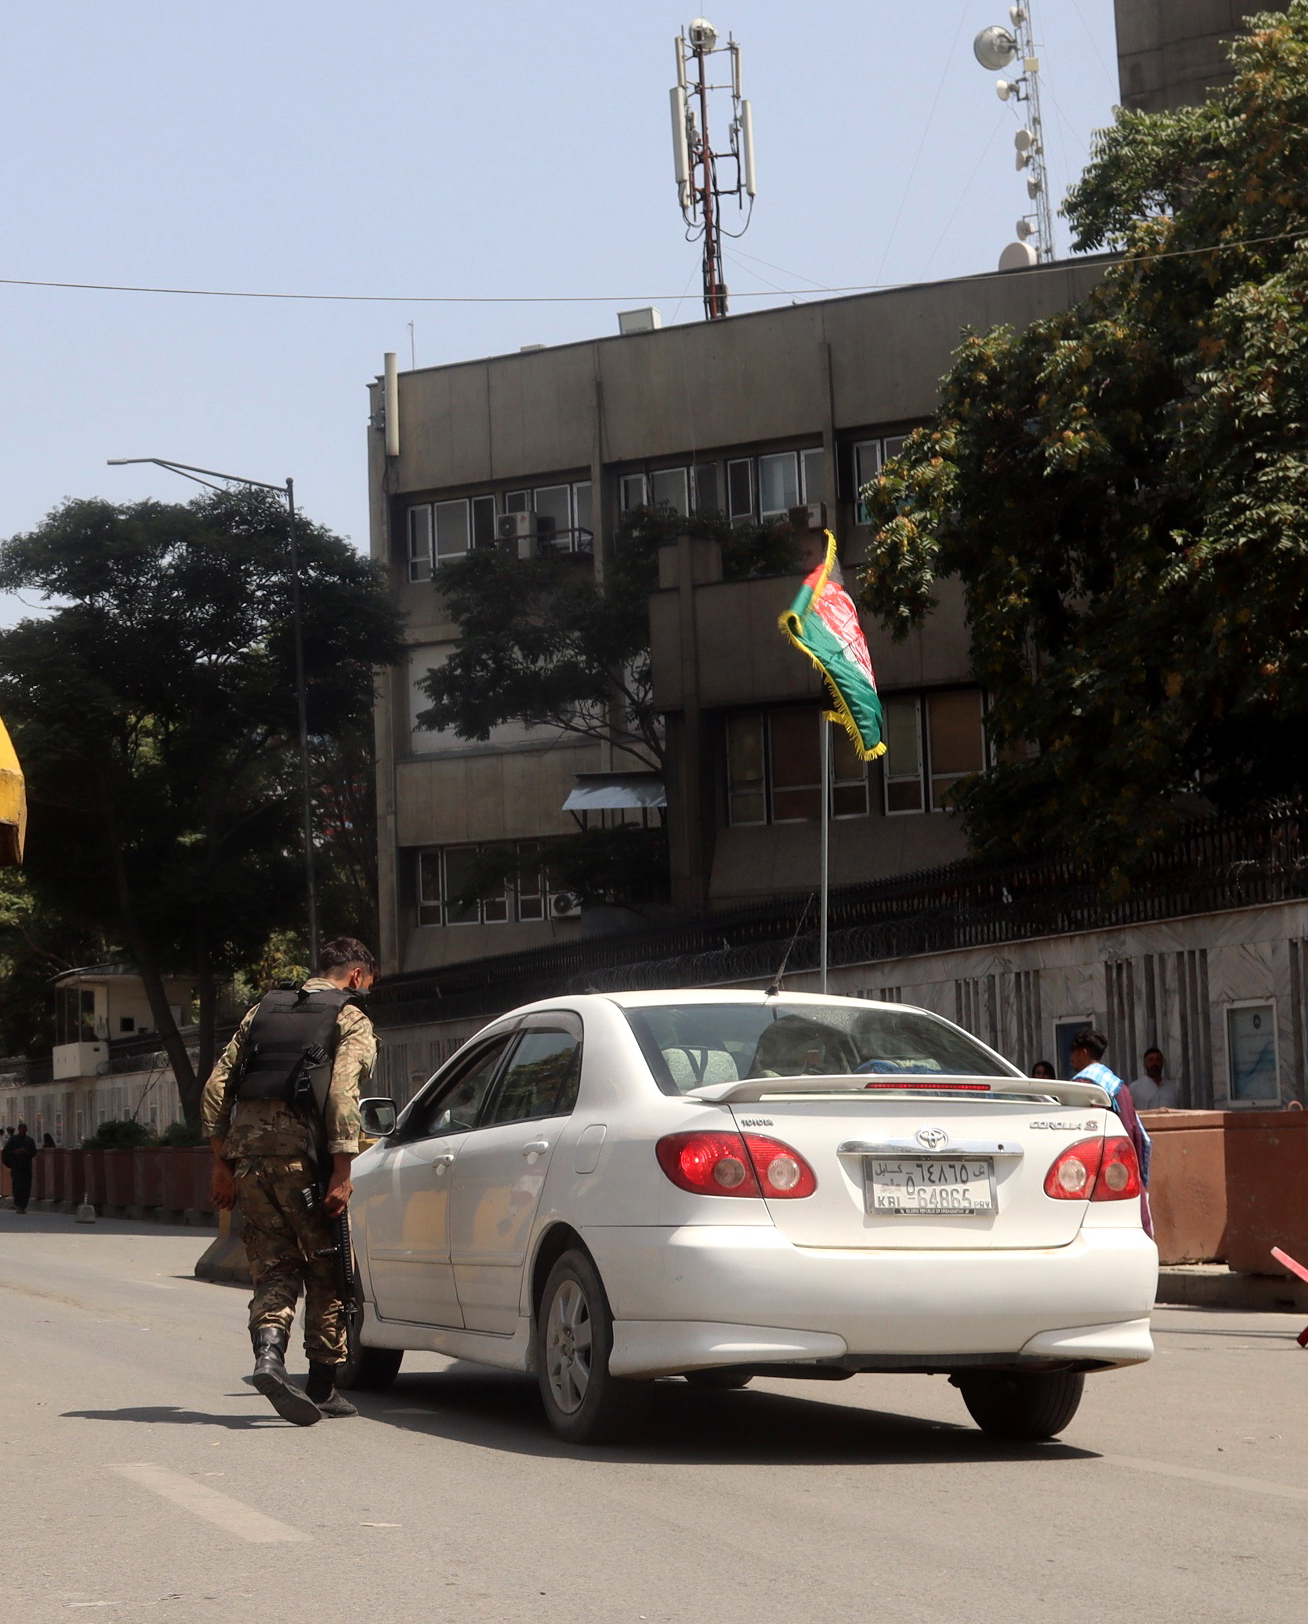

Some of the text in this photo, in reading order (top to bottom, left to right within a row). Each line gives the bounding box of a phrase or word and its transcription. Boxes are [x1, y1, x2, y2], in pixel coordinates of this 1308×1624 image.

[740, 1118, 774, 1127] TOYOTA
[1029, 1120, 1082, 1131] COROLLA
[916, 1187, 972, 1209] 64865
